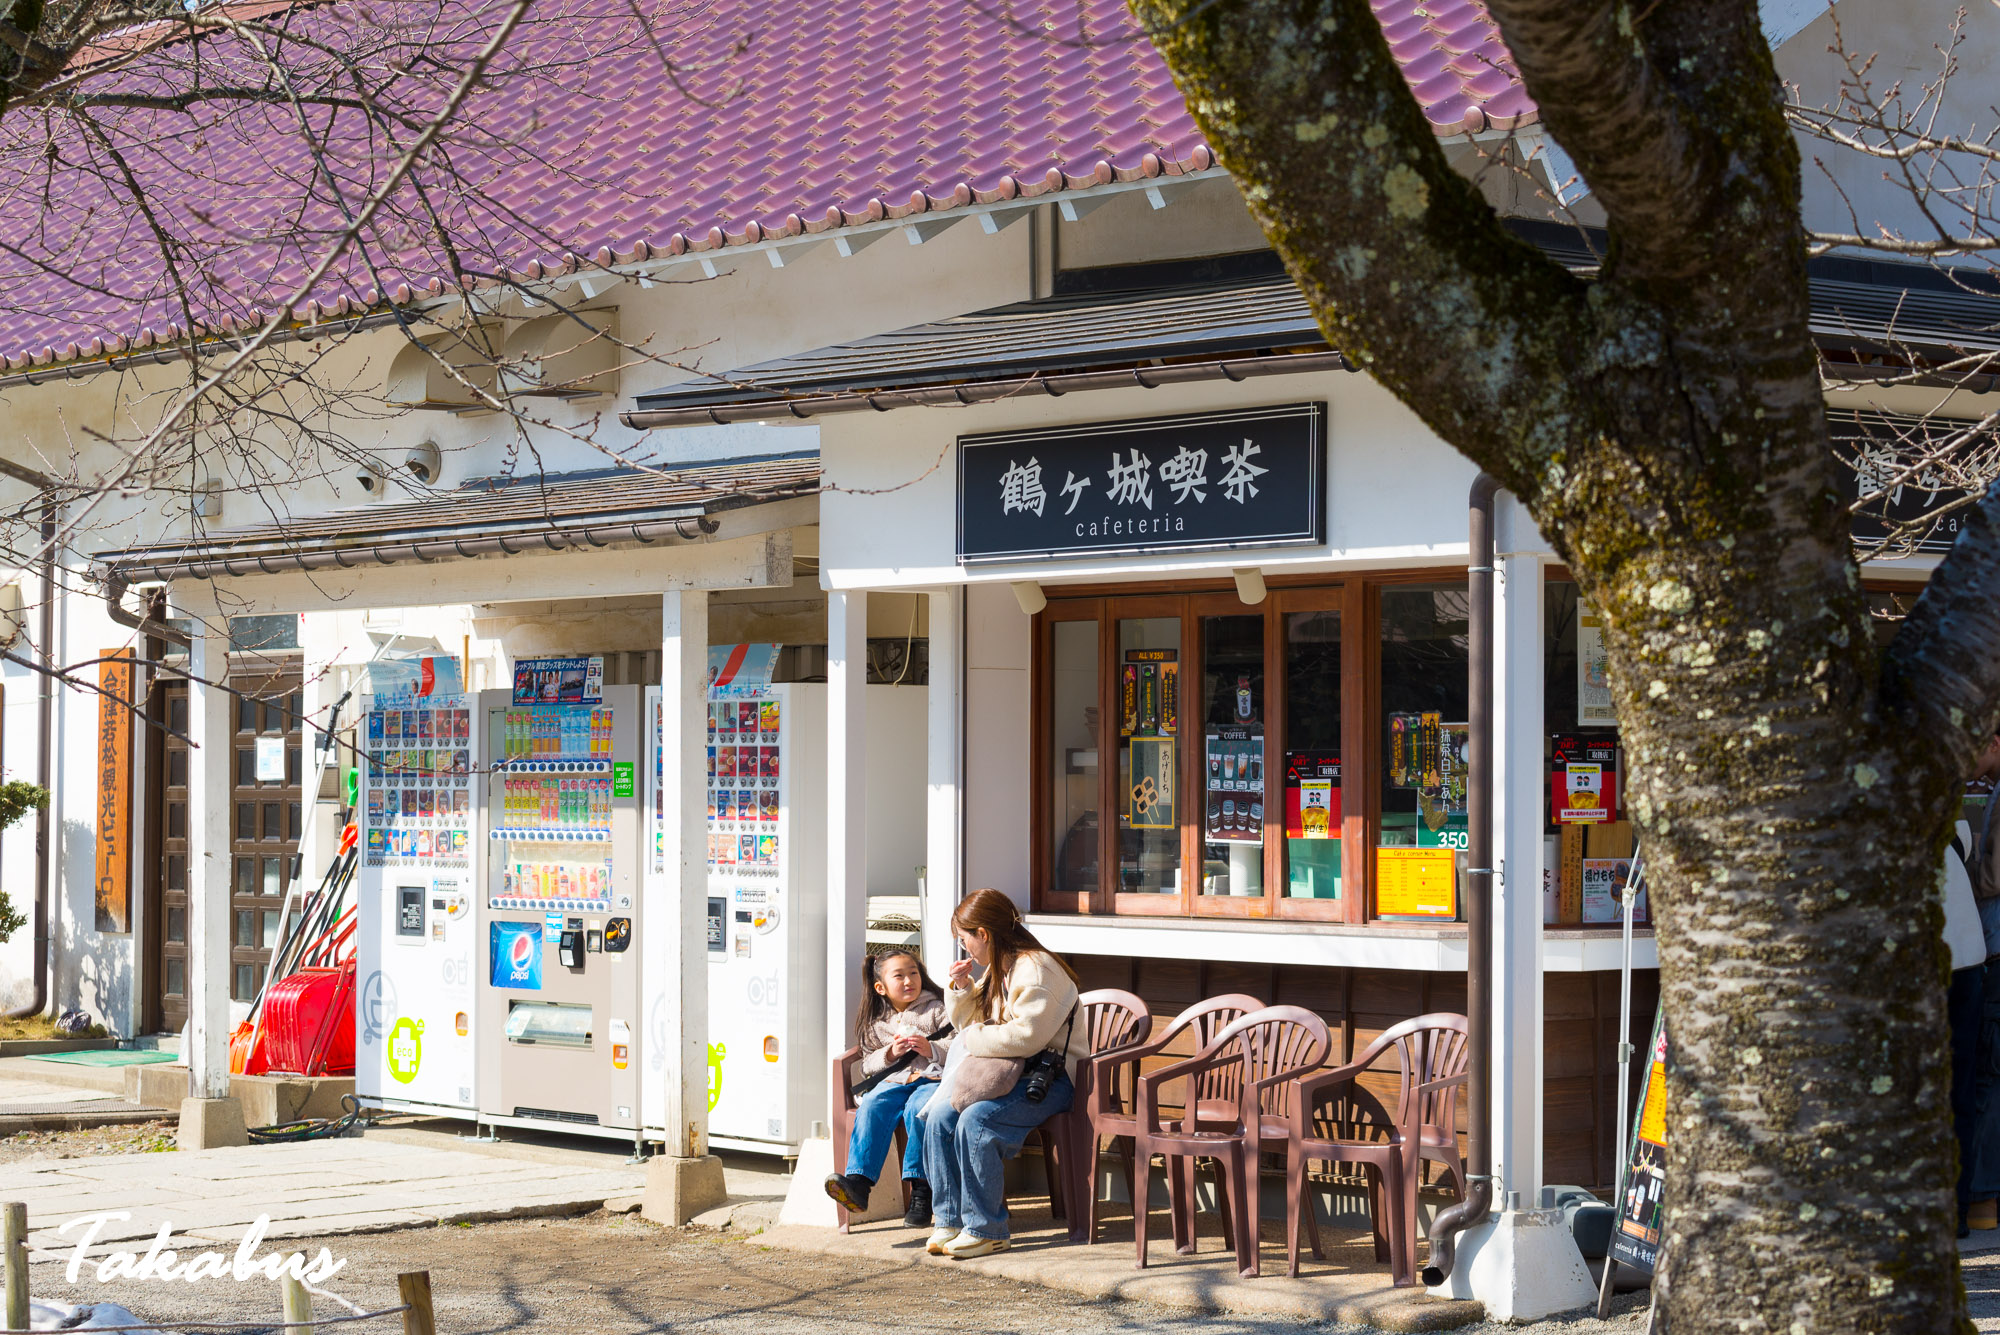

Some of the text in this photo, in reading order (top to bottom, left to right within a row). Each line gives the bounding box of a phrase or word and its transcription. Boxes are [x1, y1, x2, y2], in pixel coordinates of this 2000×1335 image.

[999, 438, 1270, 518] 鶴ヶ城喫茶
[1075, 512, 1185, 537] cafeteria
[1138, 651, 1148, 660] ALL
[515, 662, 535, 671] レッドブル
[119, 661, 127, 725] 般財団法人
[1223, 731, 1247, 740] COFFEE
[1161, 749, 1170, 793] あげもち
[1440, 728, 1451, 812] 抹茶白玉あん
[1437, 831, 1469, 848] 350
[510, 969, 530, 982] pepsi
[396, 1047, 413, 1058] eco
